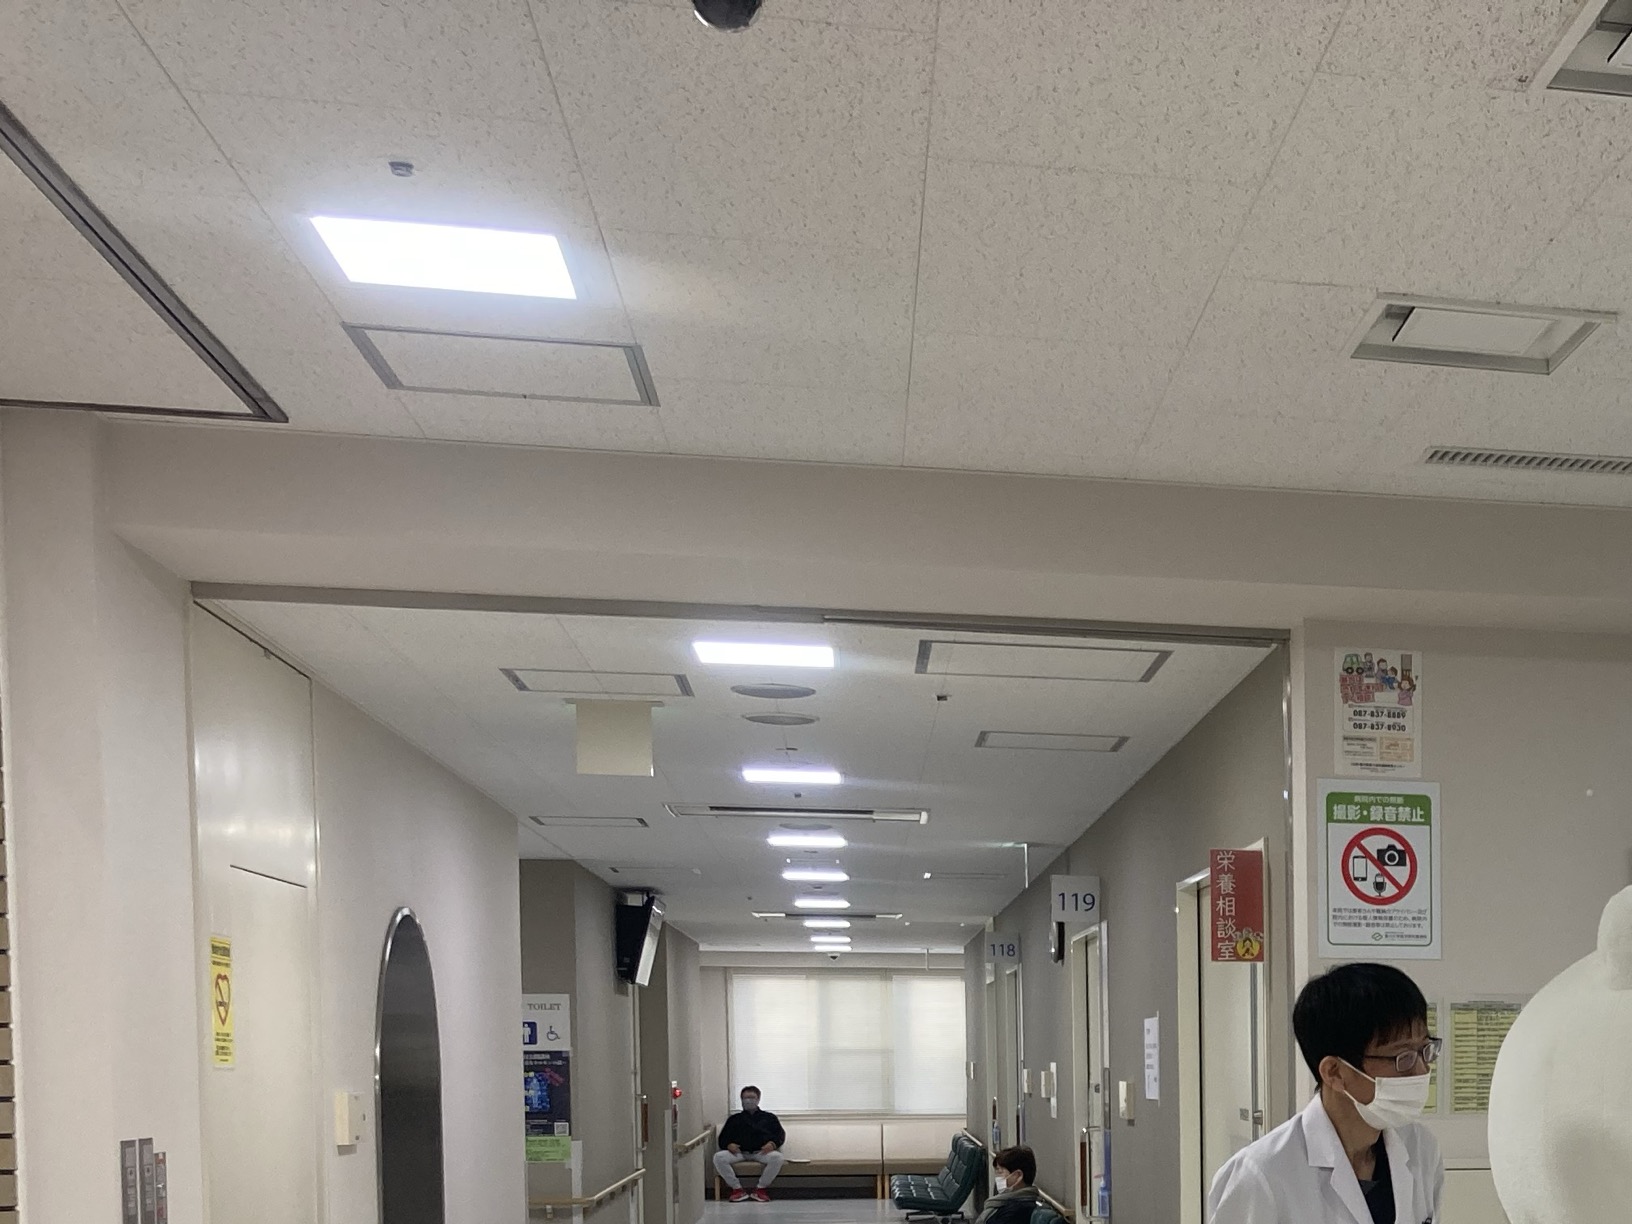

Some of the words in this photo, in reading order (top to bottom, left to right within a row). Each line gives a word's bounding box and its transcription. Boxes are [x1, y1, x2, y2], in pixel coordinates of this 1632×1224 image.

[1333, 804, 1425, 822] 撮影・録音禁止
[1058, 892, 1096, 912] 119
[1216, 850, 1236, 961] 栄養相談室
[990, 943, 1016, 957] 118
[527, 1003, 561, 1011] TOILET
